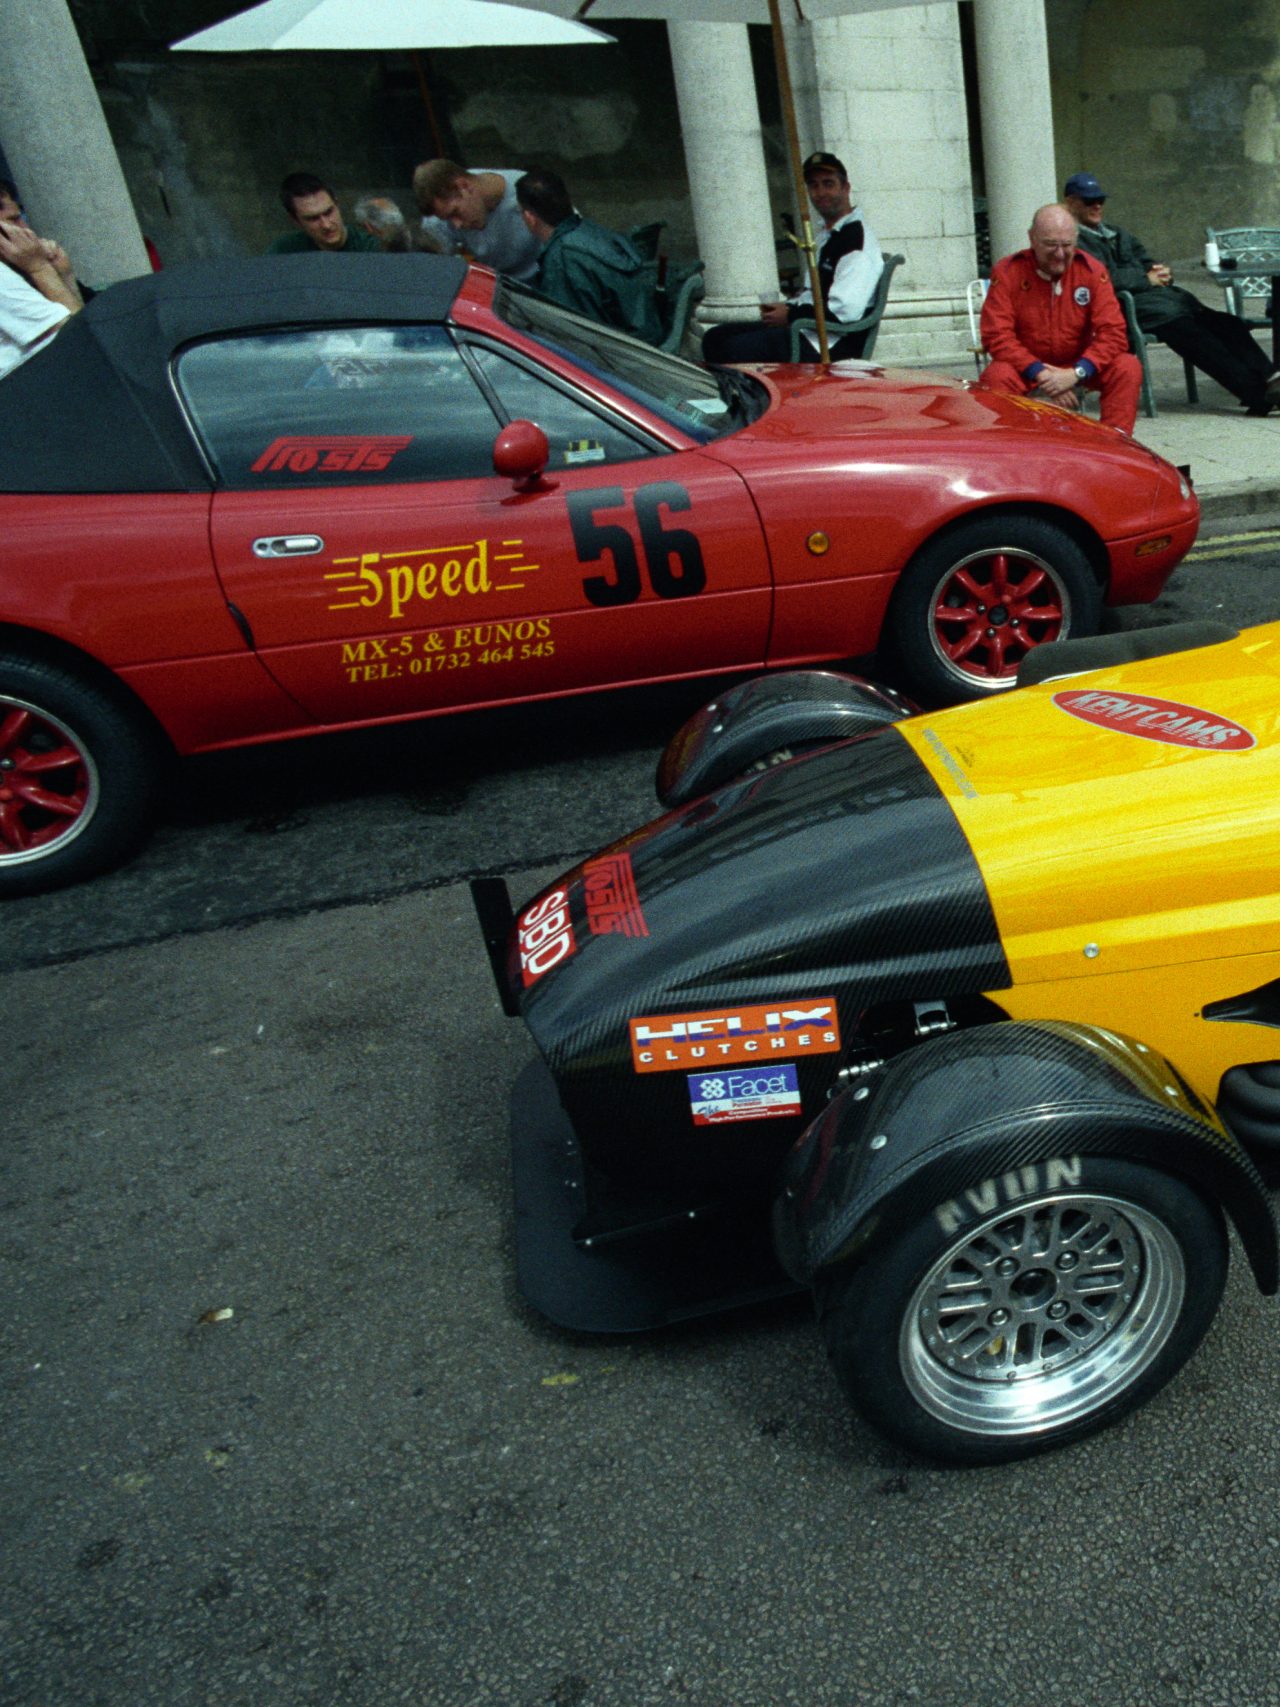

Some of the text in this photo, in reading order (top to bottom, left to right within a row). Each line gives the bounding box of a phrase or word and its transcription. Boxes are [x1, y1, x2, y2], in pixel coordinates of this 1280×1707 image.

[566, 481, 707, 606] 56
[341, 618, 551, 664] MX-5 & EUNOS
[345, 640, 556, 683] TEL: 01732 464 545
[1062, 691, 1241, 746] KENT CAMS
[521, 890, 572, 975] SBD
[635, 1006, 833, 1048] HELIX
[638, 1031, 837, 1063] CLUTCHES
[727, 1073, 788, 1097] Facet
